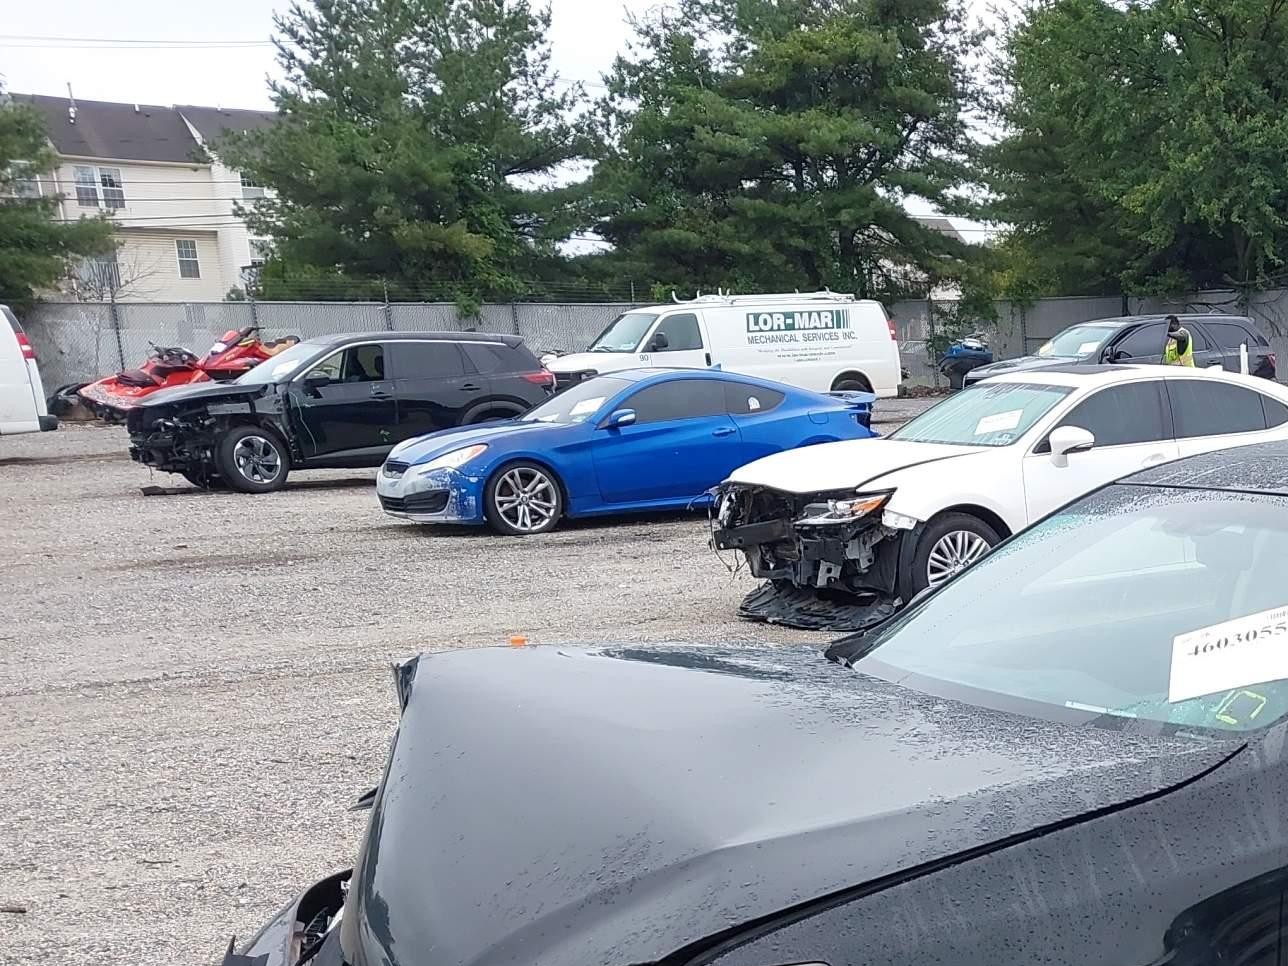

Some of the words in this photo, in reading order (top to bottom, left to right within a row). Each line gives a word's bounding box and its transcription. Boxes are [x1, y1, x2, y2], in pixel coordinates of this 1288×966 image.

[748, 311, 833, 331] LOR-MAR
[747, 333, 799, 345] MECHANICAL
[802, 331, 840, 343] SERVICES
[842, 331, 858, 341] INC.
[639, 354, 649, 362] 90
